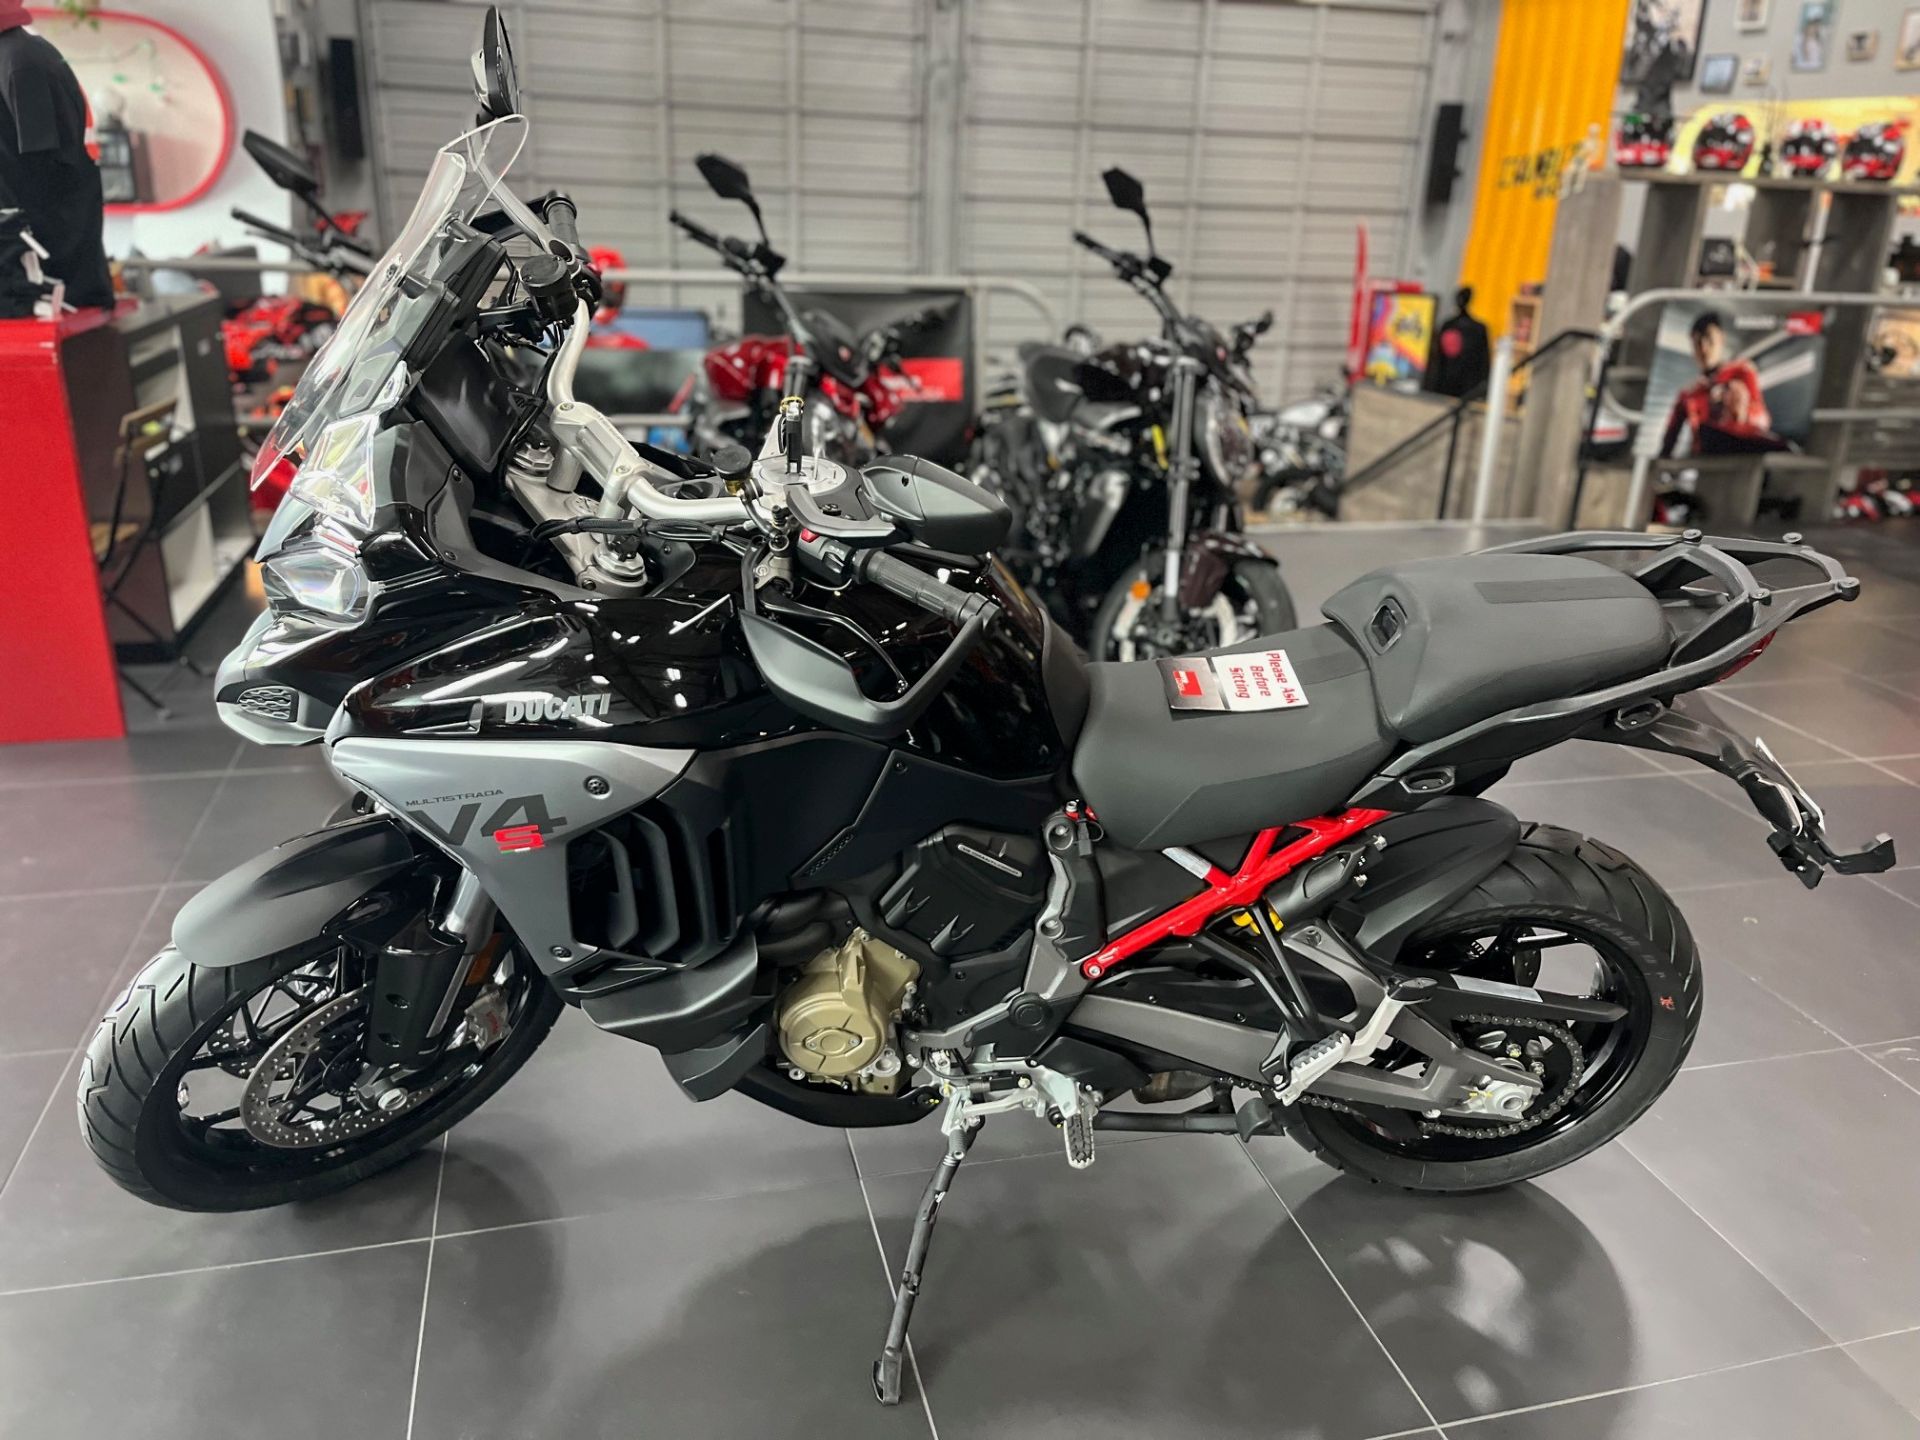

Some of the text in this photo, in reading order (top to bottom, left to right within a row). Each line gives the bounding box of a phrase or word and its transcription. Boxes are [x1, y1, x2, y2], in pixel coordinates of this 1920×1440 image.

[1229, 667, 1251, 699] Sitting
[1250, 665, 1272, 697] Before
[1265, 652, 1300, 705] Please Ask
[505, 693, 611, 723] DUCATI
[405, 788, 504, 807] MULTISTRADA
[405, 793, 568, 847] V4
[493, 824, 545, 852] S
